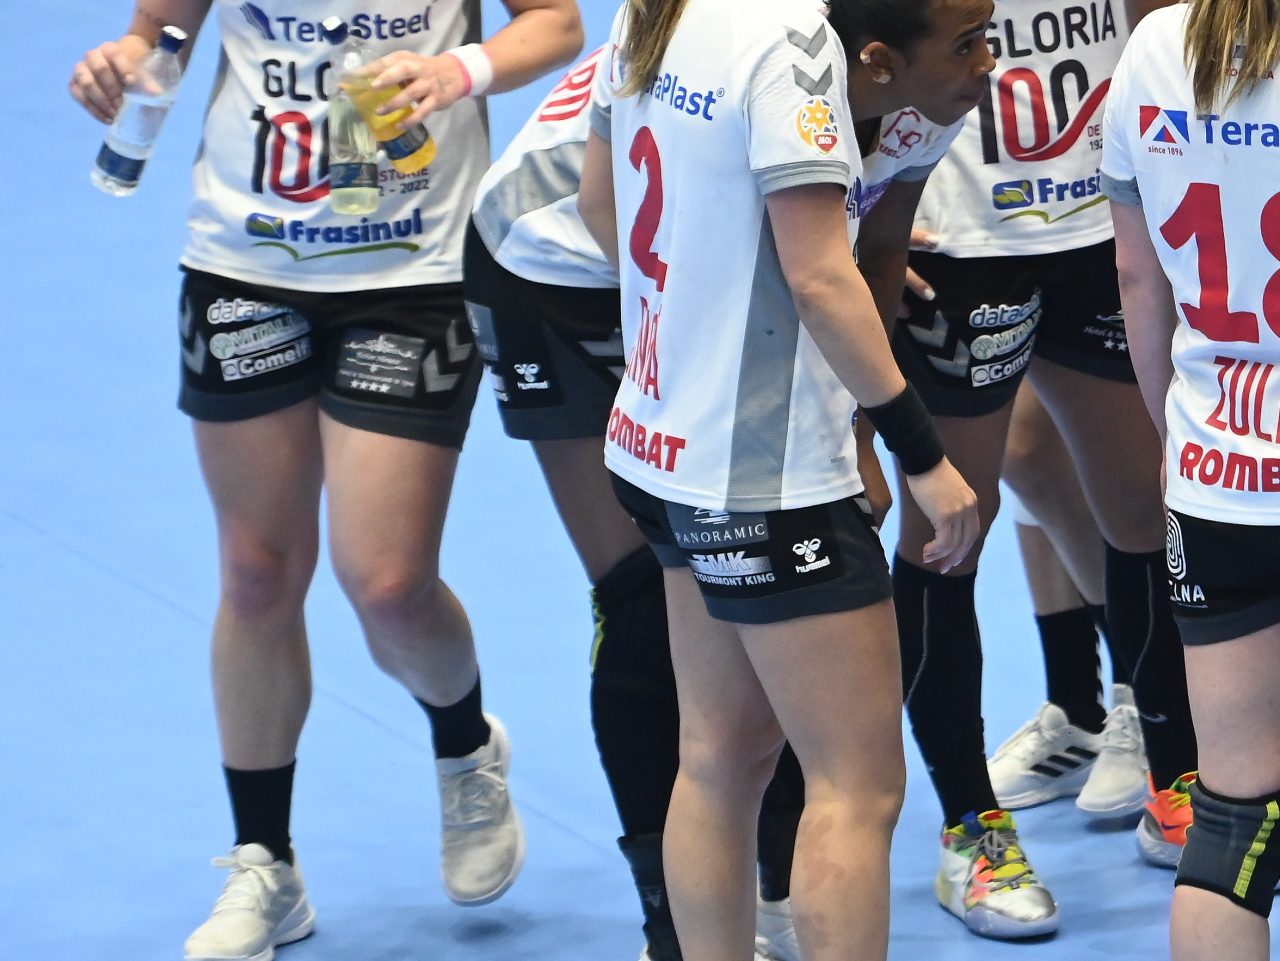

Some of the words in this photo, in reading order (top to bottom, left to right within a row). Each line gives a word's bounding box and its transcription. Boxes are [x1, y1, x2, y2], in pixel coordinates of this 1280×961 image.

[818, 135, 833, 144] MOL
[1147, 146, 1166, 156] since
[1166, 146, 1184, 157] 1896
[399, 180, 429, 194] 2022
[628, 125, 669, 293] 2
[288, 207, 423, 244] Frasinul
[607, 407, 686, 473] OMBAT
[676, 522, 766, 544] PANORAMIC
[691, 549, 752, 573] TMK
[795, 556, 831, 574] hummel
[694, 571, 745, 587] TOURMONT
[746, 571, 776, 587] KING
